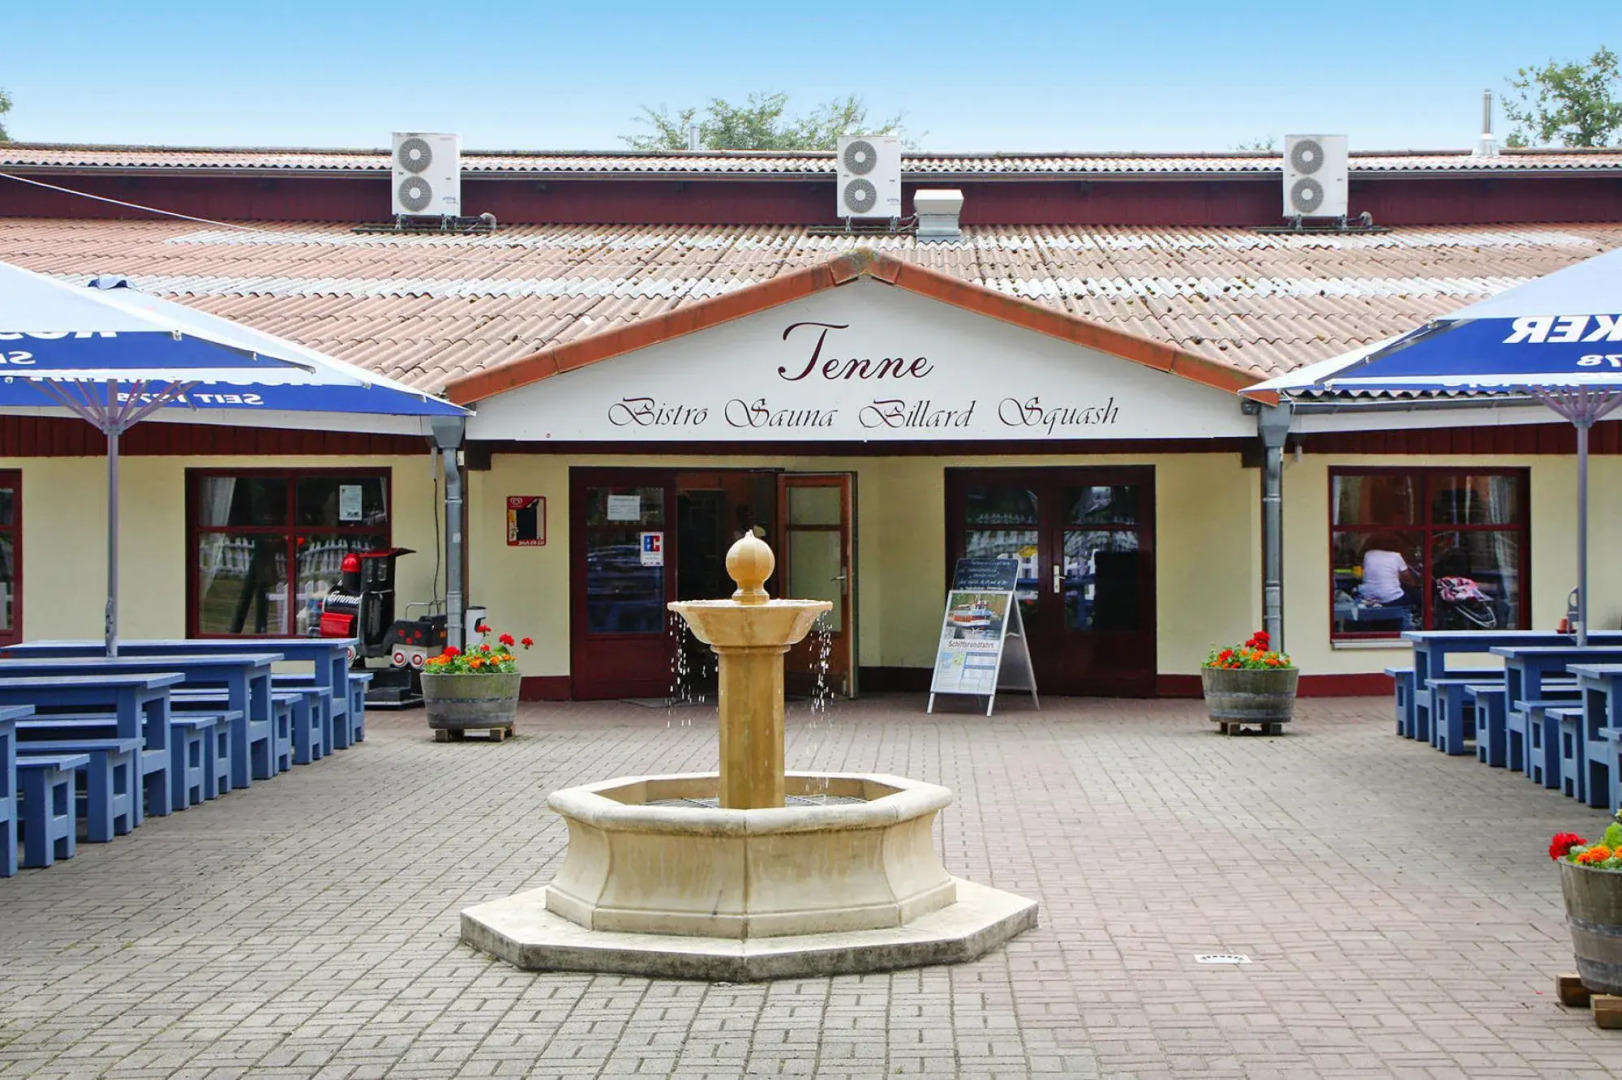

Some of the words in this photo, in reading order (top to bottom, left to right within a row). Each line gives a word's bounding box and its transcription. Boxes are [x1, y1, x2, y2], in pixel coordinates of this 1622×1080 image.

[777, 321, 935, 381] Tenne
[608, 397, 708, 427] Bistro
[724, 398, 838, 428] Sauna
[858, 399, 977, 429] Billard
[998, 397, 1119, 435] Squash
[328, 590, 359, 604] Emma
